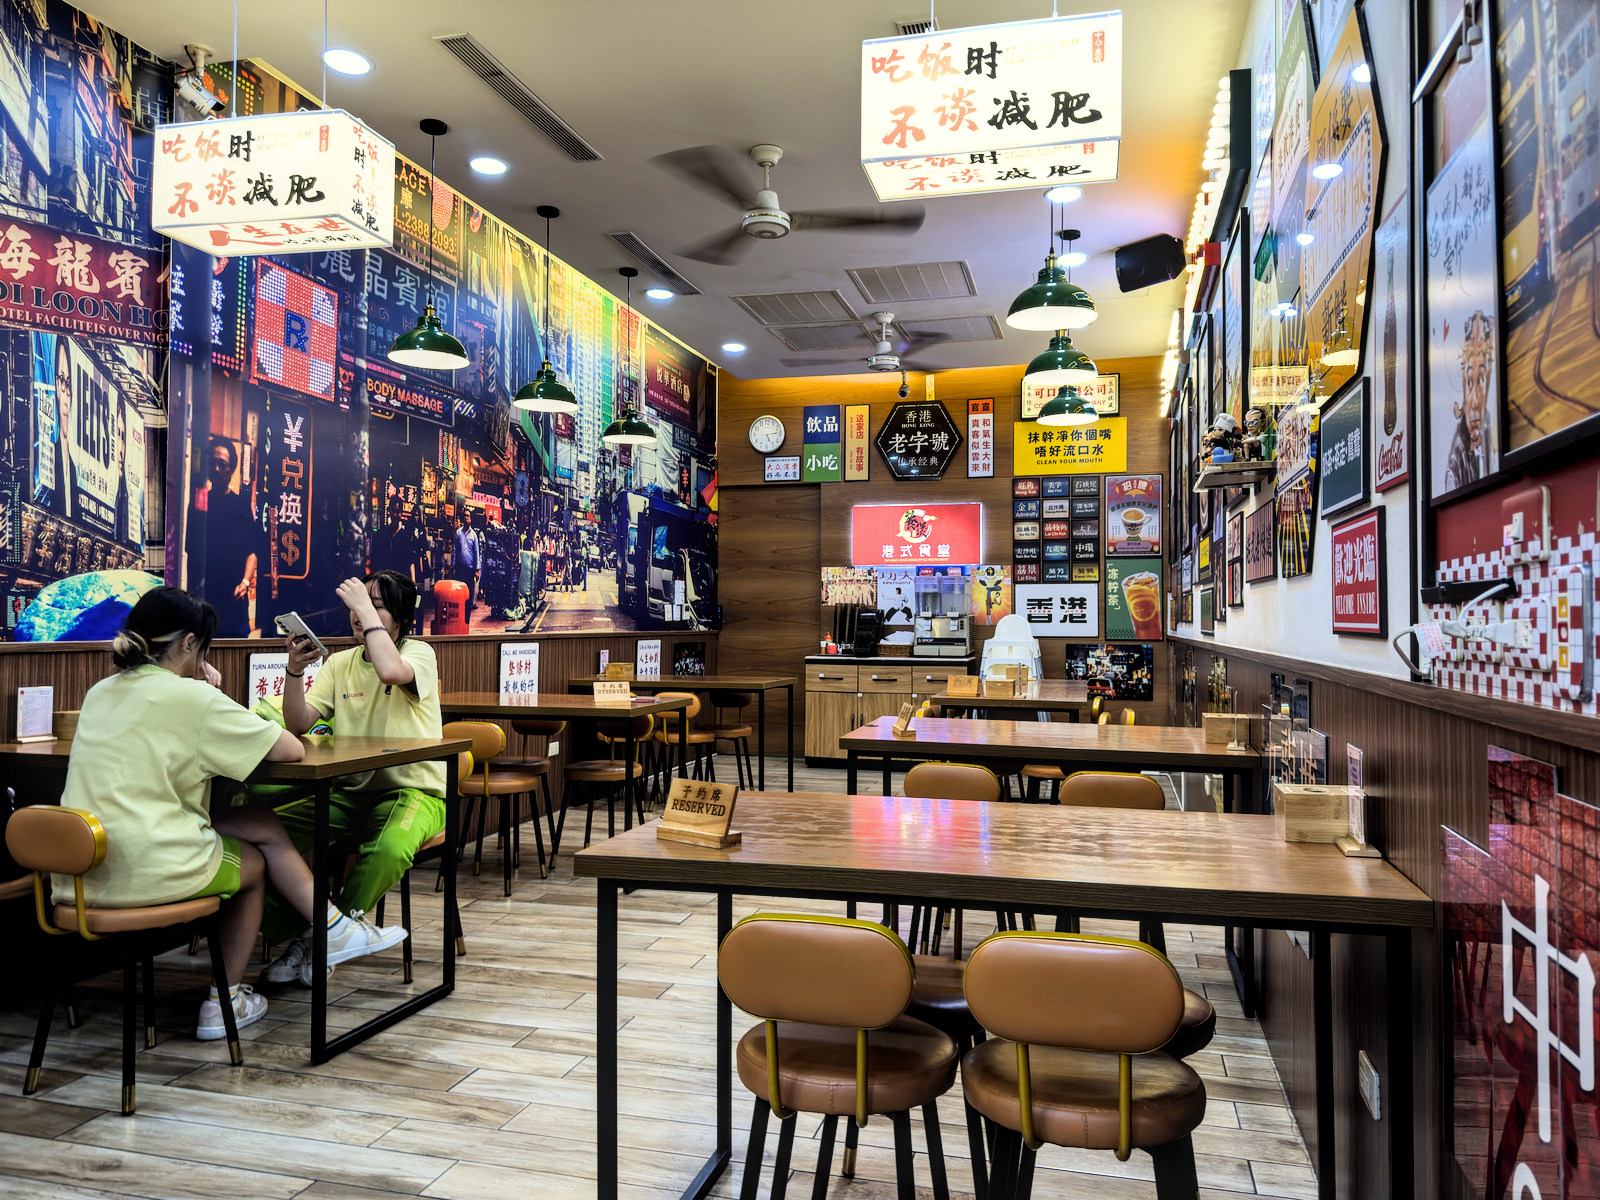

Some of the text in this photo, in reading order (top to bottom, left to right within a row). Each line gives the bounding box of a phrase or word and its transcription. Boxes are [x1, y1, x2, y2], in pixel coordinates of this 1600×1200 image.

[871, 41, 1002, 83] 吃饭时
[882, 87, 1102, 149] 不谈减肥
[162, 130, 256, 162] 吃饭时
[905, 165, 1091, 190] 不谈减肥
[168, 168, 325, 219] 不谈减肥
[0, 224, 169, 306] 海龍賓
[31, 286, 122, 323] LOON
[36, 312, 106, 335] FACILITEIS
[108, 325, 141, 341] OVER
[367, 377, 396, 398] BODY
[397, 387, 443, 414] MASSAGE
[77, 362, 110, 470] IELTS
[806, 416, 839, 434] 飲品
[856, 414, 864, 440] 这家店
[905, 410, 932, 424] 香港
[887, 431, 950, 454] 老字號
[971, 419, 980, 473] 貴客似雲來
[982, 418, 991, 472] 和氣生大財
[1034, 444, 1104, 457] 唔好流口水
[805, 454, 839, 472] 小吃
[897, 456, 939, 467] 传承经典
[882, 544, 950, 558] 港式食堂
[1075, 543, 1094, 553] 中環
[1335, 533, 1375, 587] 歡迎光臨
[879, 570, 915, 582] 功夫
[1026, 597, 1087, 624] 香港
[1335, 592, 1376, 615] WELCOME INSIDE
[671, 799, 726, 817] RESERVED
[1502, 872, 1596, 1143] 中
